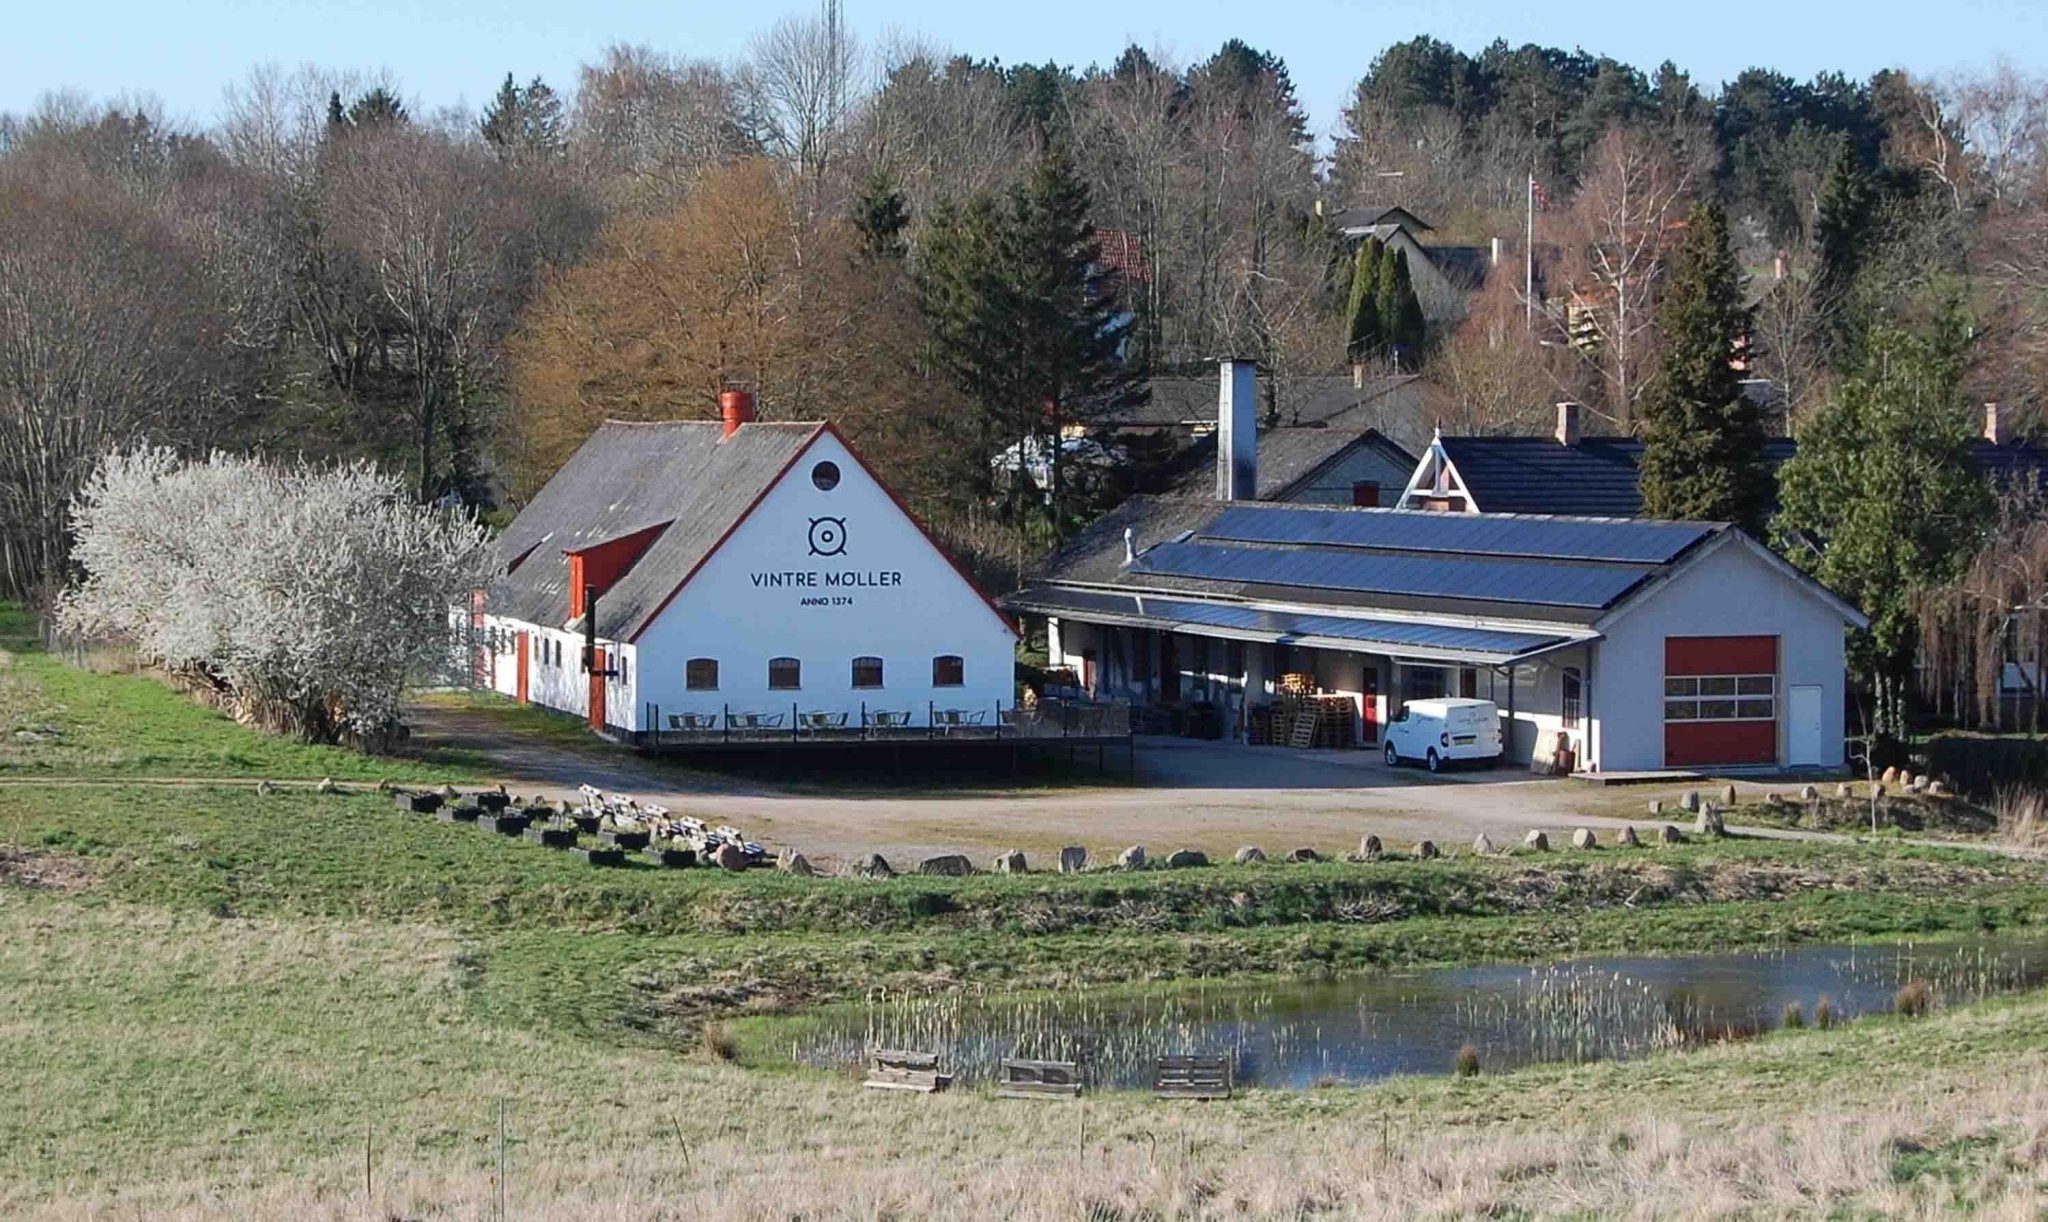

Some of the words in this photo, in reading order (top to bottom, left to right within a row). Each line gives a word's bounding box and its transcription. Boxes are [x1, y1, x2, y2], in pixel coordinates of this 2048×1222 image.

[750, 571, 818, 587] VINTRE
[825, 571, 902, 587] MØLLER
[800, 596, 829, 606] ANNO
[832, 596, 853, 606] 1374
